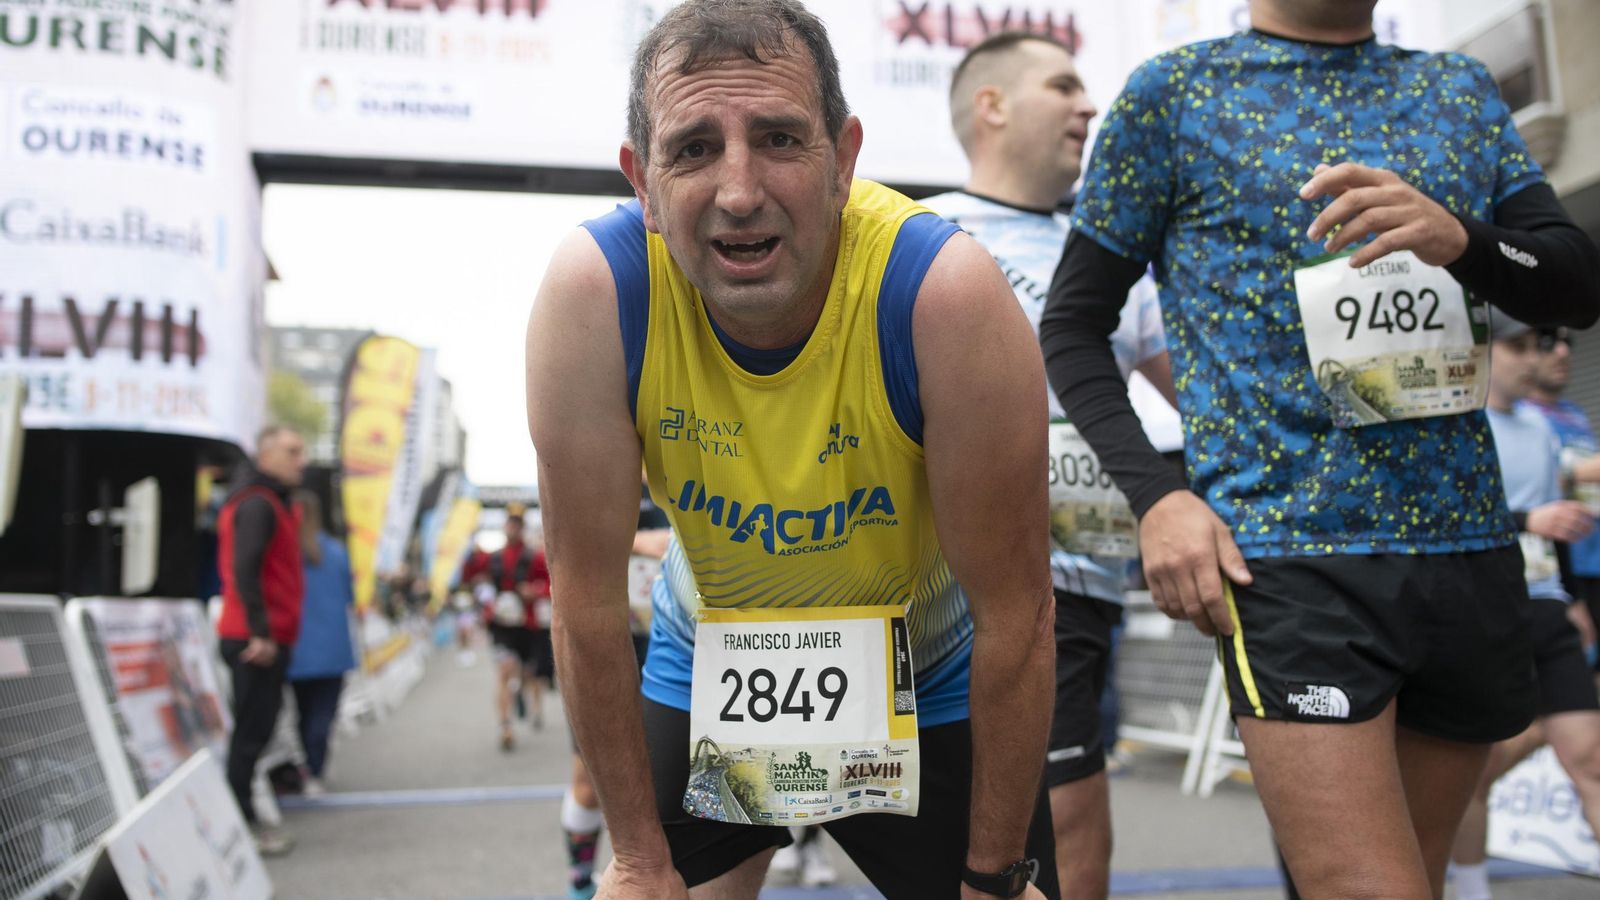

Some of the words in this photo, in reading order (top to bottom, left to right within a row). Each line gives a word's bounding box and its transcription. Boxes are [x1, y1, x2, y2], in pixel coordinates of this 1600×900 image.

[22, 125, 204, 171] OURENSE
[1335, 288, 1445, 340] 9482
[0, 295, 198, 367] LVIII
[687, 428, 744, 458] DNTAL
[665, 476, 896, 555] IMIACTIVA
[850, 517, 898, 541] PORTIVA
[778, 537, 849, 556] ASOCIACIÓN
[724, 633, 791, 650] FRANCISCO
[794, 631, 842, 650] JAVIER
[719, 666, 848, 723] 2849
[1287, 693, 1330, 705] NORTH
[1306, 684, 1330, 695] THE
[1298, 704, 1330, 716] FACE
[851, 752, 878, 760] OURENSE
[773, 763, 797, 771] SAN
[844, 761, 902, 781] XLVIII
[774, 783, 828, 792] OURENSE
[798, 797, 829, 805] CaixaBank
